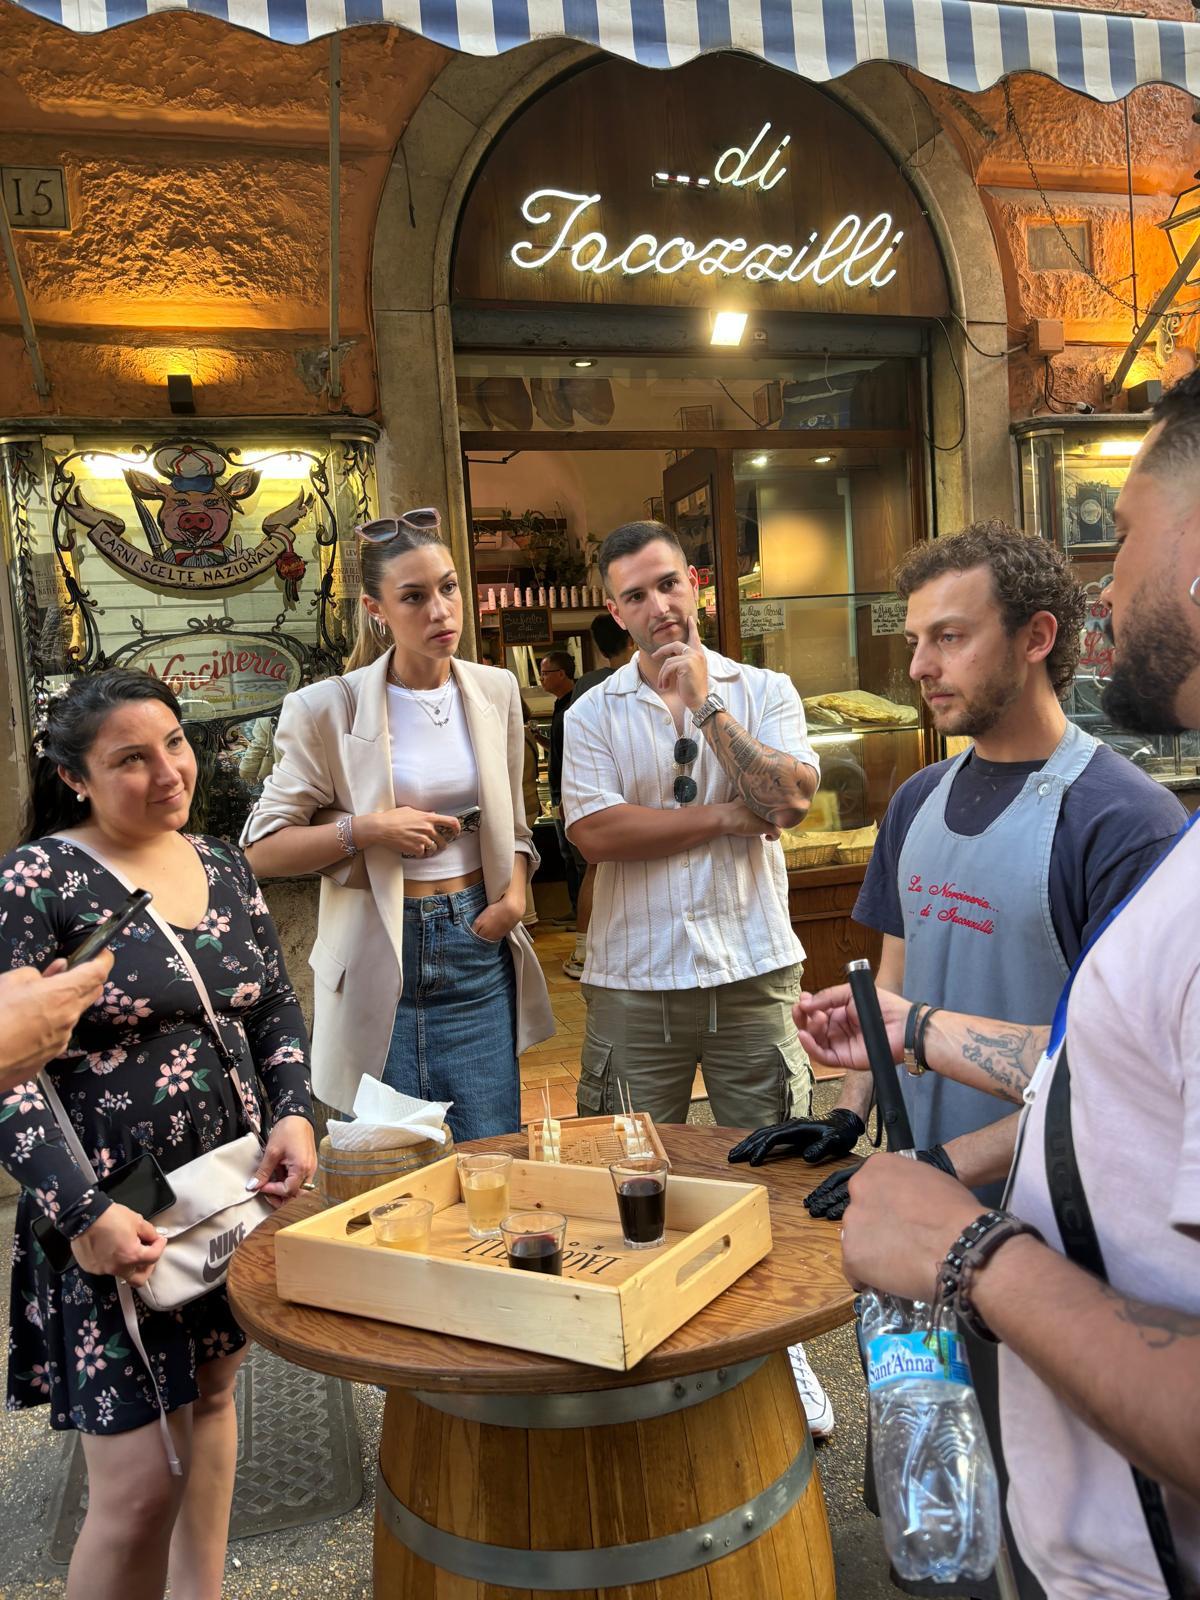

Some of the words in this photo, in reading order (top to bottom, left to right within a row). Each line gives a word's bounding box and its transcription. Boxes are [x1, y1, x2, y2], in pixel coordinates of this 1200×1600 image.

[11, 178, 53, 216] 15
[99, 531, 138, 565] CARNI
[140, 562, 196, 582] SCELTE
[203, 542, 278, 580] NAZIONALI
[147, 650, 288, 697] Norcineria
[908, 875, 923, 892] La
[920, 903, 933, 917] di
[209, 1222, 247, 1264] NIKE
[869, 1353, 935, 1382] Sant'Anna
